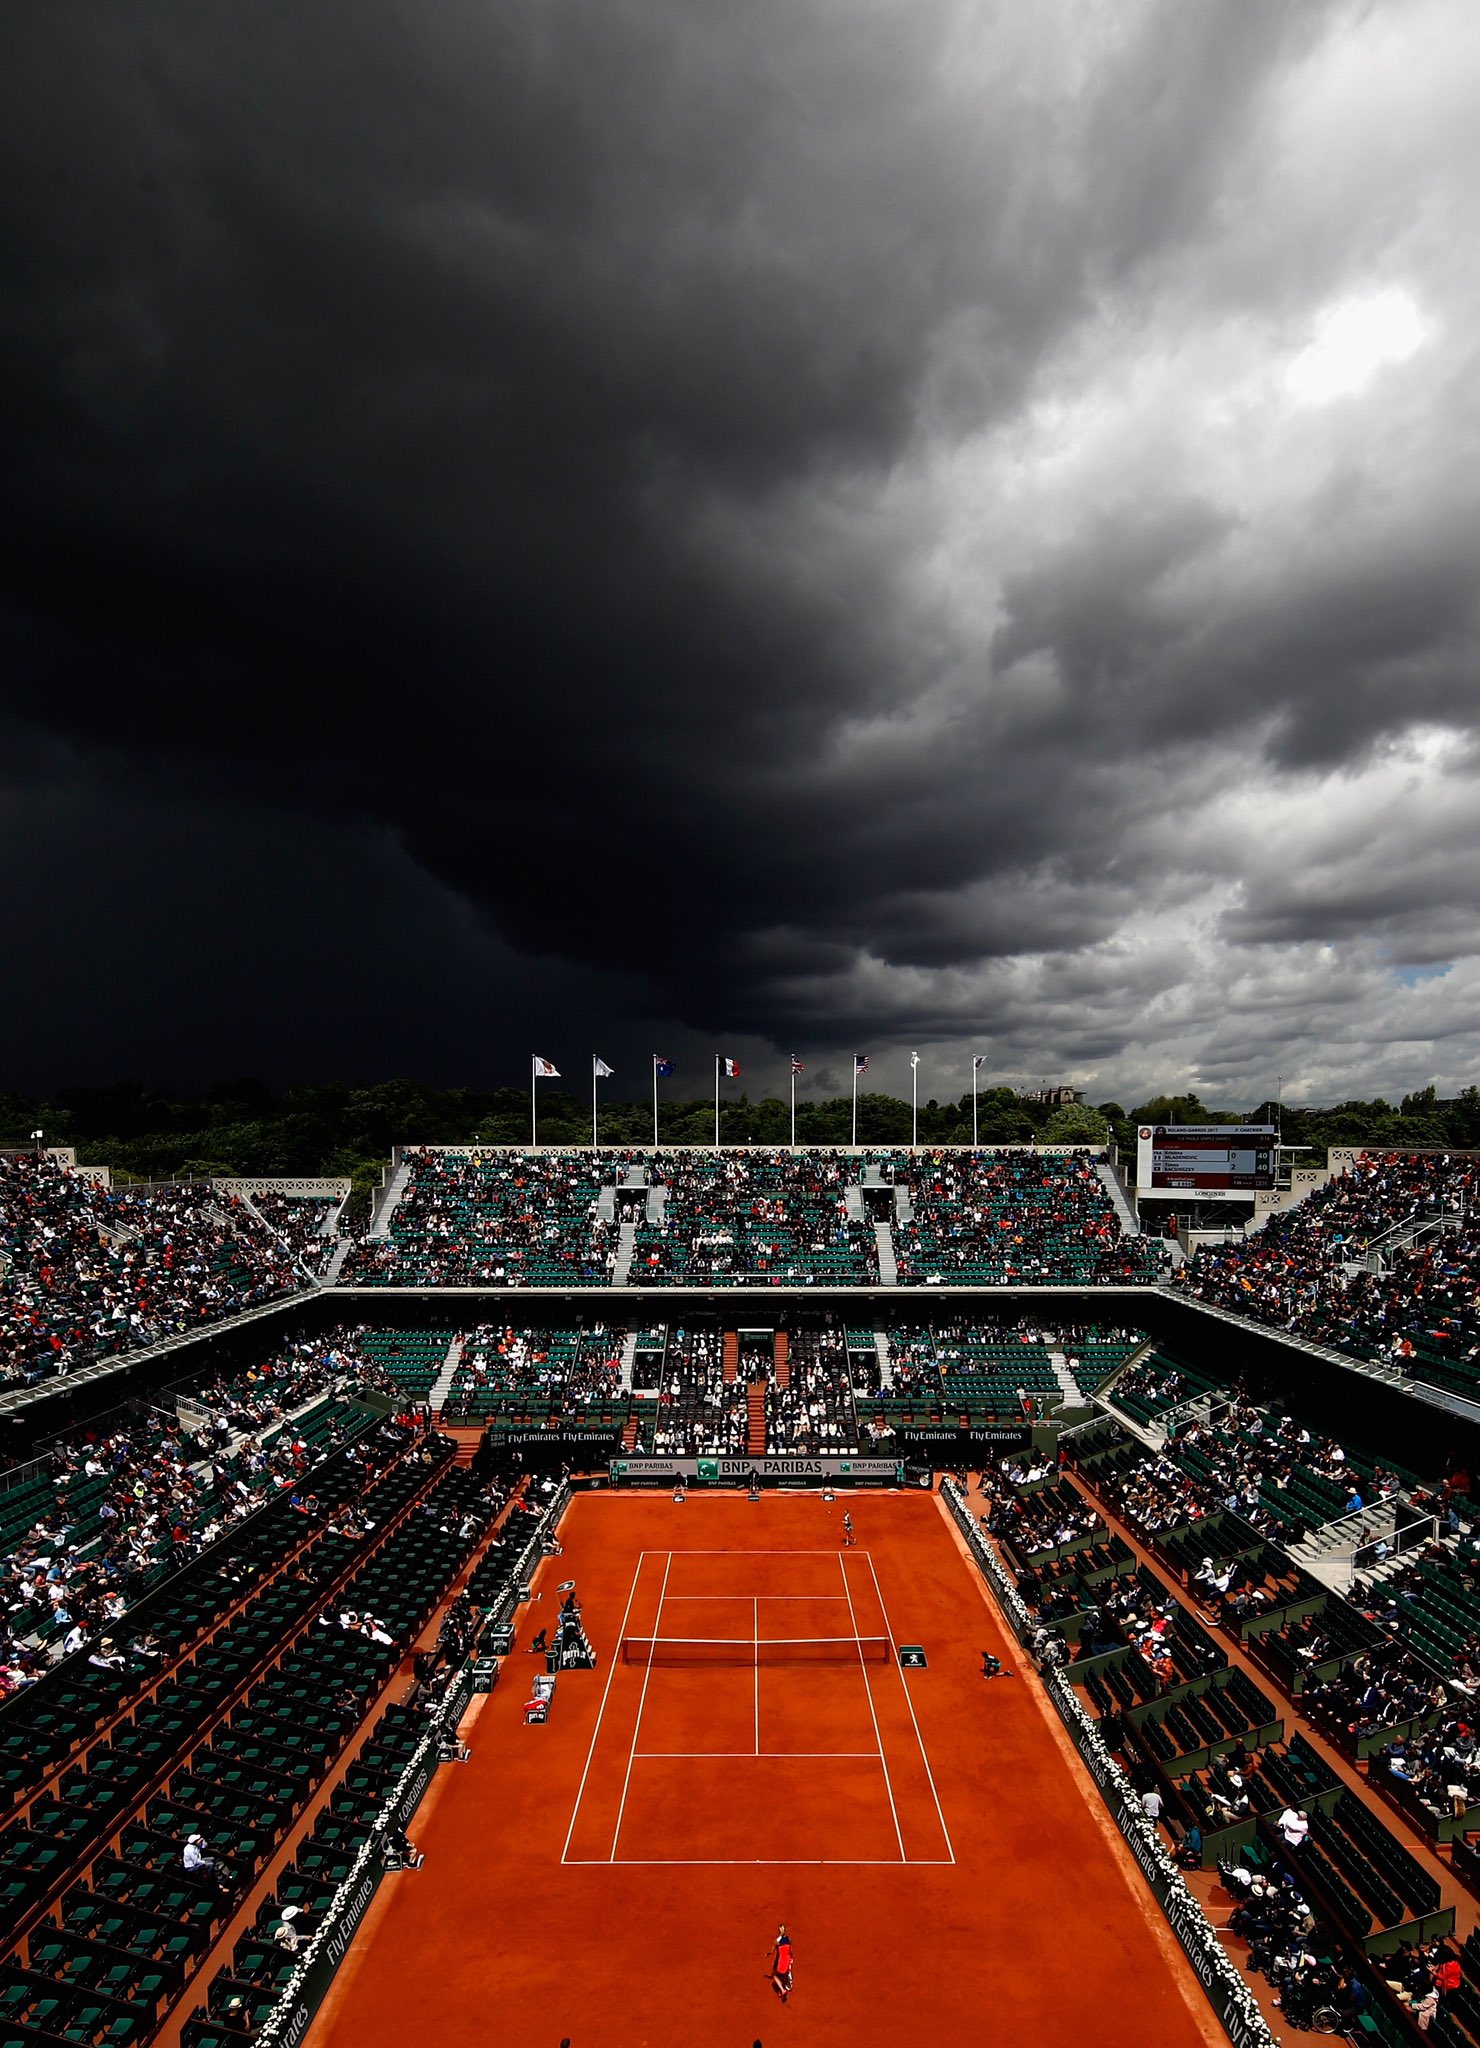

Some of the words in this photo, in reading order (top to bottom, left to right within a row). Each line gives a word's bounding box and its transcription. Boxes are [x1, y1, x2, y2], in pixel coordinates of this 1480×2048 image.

[508, 1434, 522, 1443] Fly
[523, 1432, 560, 1441] Emirates
[563, 1433, 577, 1442] Fly
[578, 1432, 614, 1441] Emirates
[905, 1431, 919, 1441] Fly
[920, 1431, 957, 1440] Emirates
[970, 1431, 985, 1441] Fly
[986, 1431, 1022, 1440] Emirates
[722, 1462, 750, 1473] BNP
[764, 1461, 822, 1473] PARIBAS
[1116, 1804, 1128, 1836] Fly
[1126, 1825, 1158, 1882] Emirates
[326, 1934, 345, 1966] Fly
[339, 1875, 373, 1941] Emirates
[1164, 1891, 1179, 1926] Fly
[1176, 1914, 1214, 1987] Emirates
[1223, 2000, 1243, 2042] Fly
